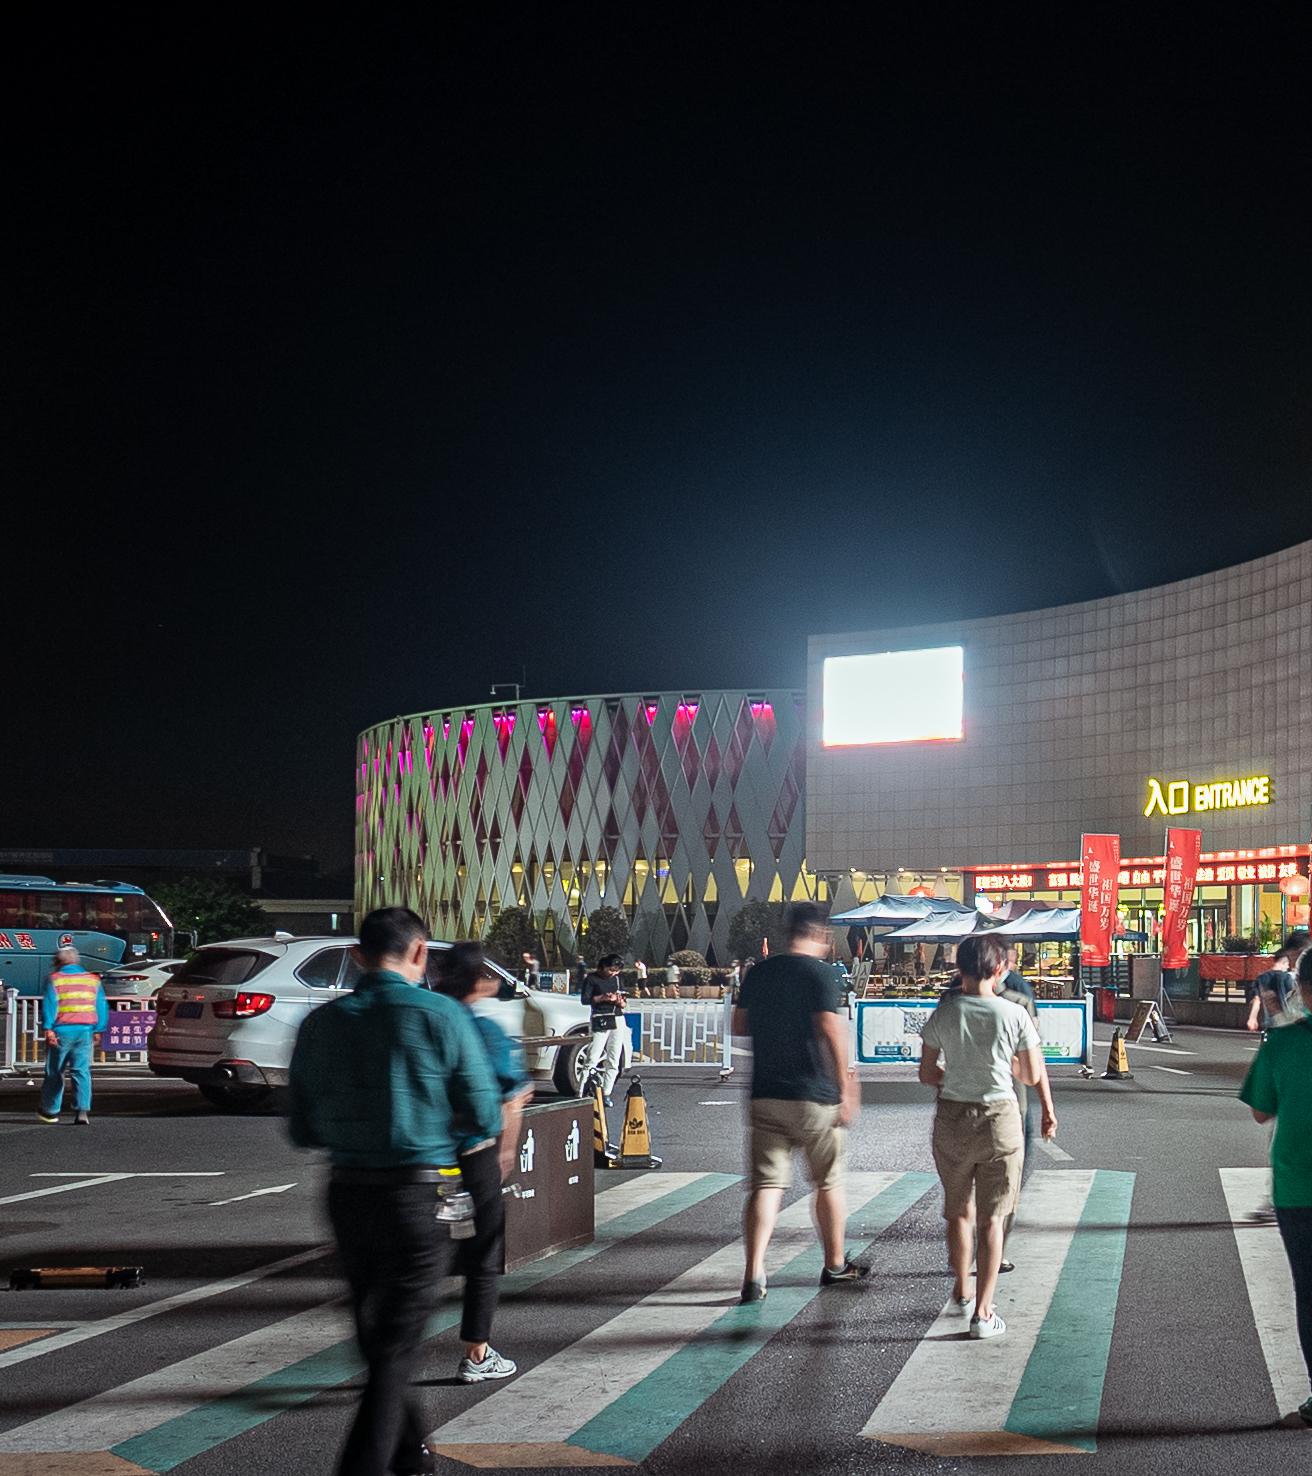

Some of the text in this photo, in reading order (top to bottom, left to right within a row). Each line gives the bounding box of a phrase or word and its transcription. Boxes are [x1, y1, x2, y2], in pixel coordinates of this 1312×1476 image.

[1144, 775, 1270, 817] 入口 ENTRANCE
[1087, 859, 1101, 913] 盛世华诞
[1100, 878, 1113, 931] 祖国万岁
[1168, 856, 1183, 913] 盛世华诞
[1177, 877, 1194, 931] 祖国万岁
